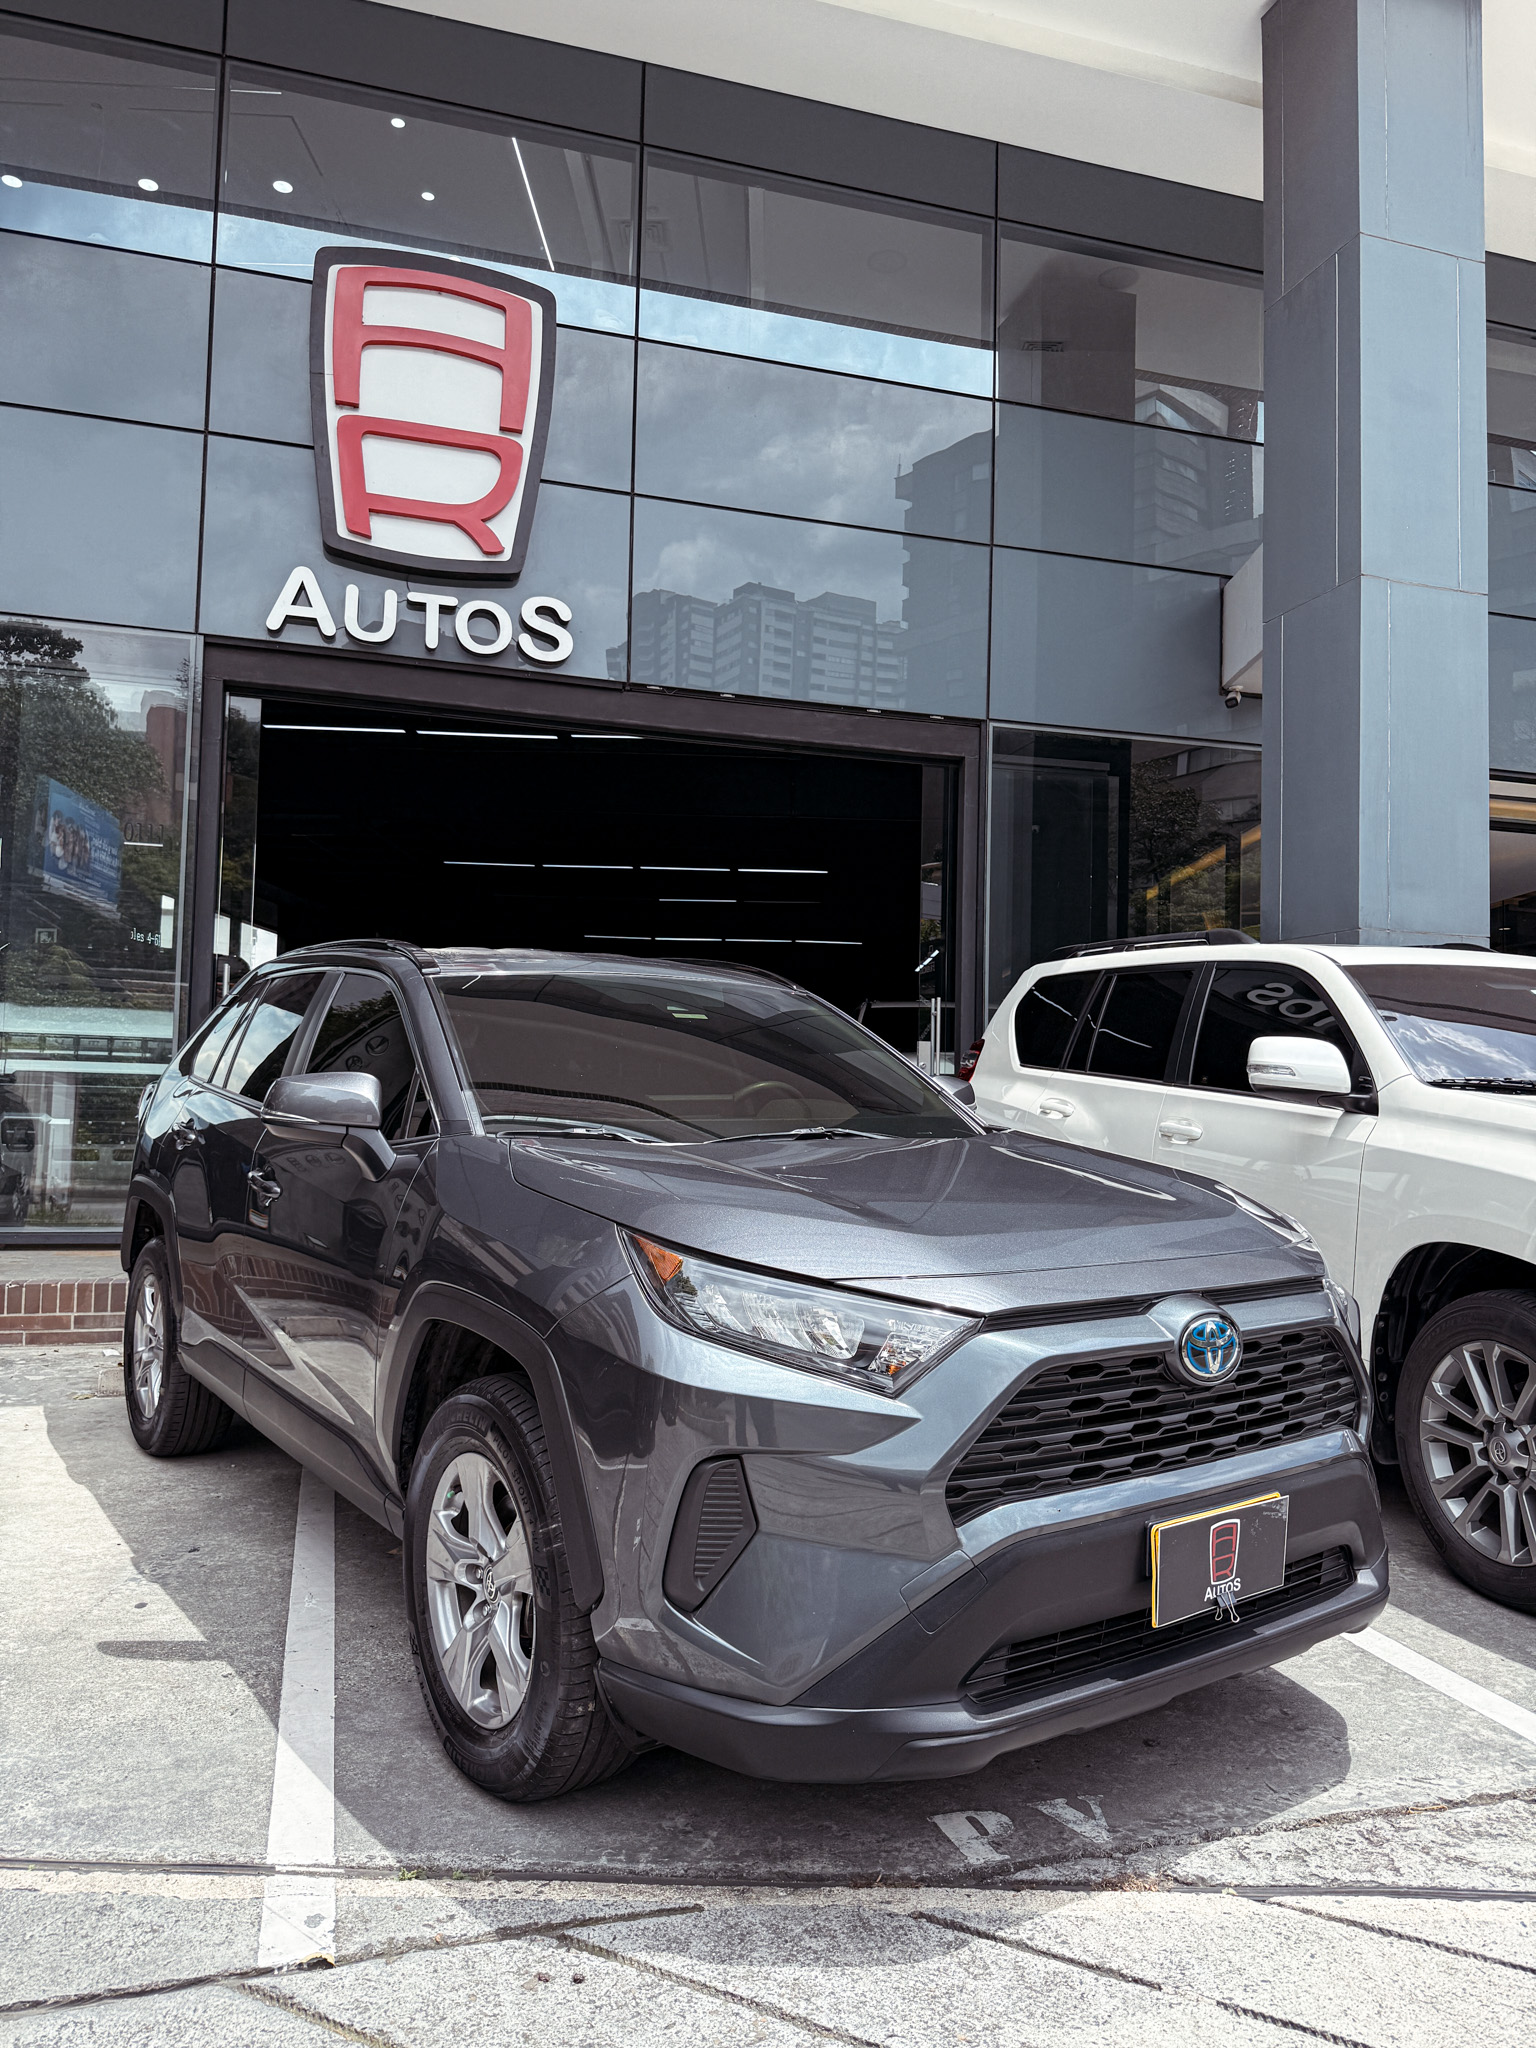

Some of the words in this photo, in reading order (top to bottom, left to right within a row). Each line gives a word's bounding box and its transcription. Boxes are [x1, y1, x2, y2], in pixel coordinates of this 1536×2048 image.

[266, 565, 573, 663] AUTOS
[493, 1434, 512, 1465] PILOT
[511, 1469, 531, 1514] SPORT
[1204, 1577, 1241, 1602] AUTOS
